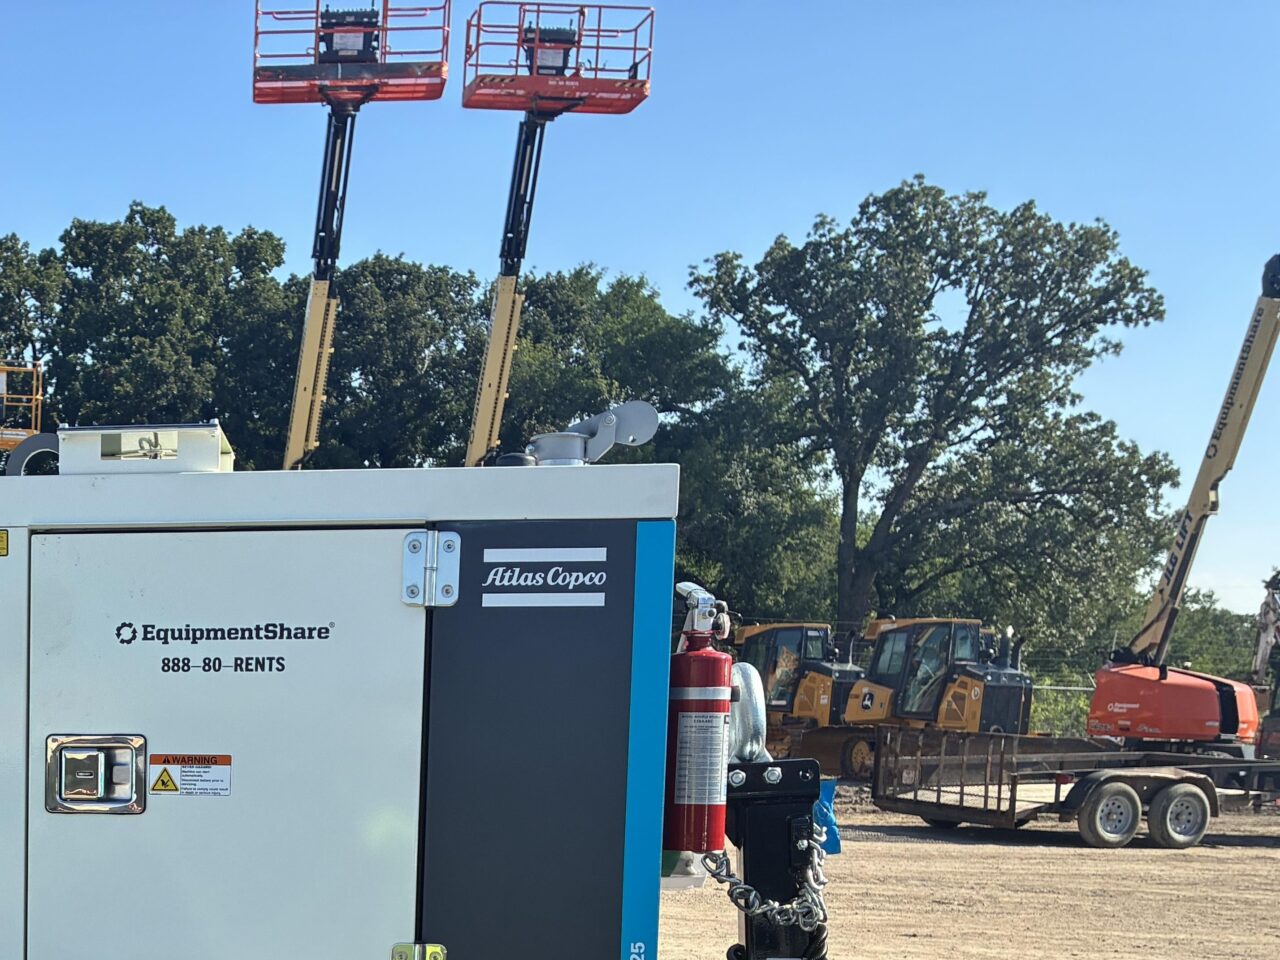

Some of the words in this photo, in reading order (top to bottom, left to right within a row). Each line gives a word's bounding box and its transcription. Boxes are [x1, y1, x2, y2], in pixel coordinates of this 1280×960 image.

[1164, 552, 1178, 586] JLG
[1176, 510, 1193, 551] LIFT
[482, 566, 545, 587] Atlas
[546, 566, 607, 590] Copco
[171, 756, 218, 764] WARNING
